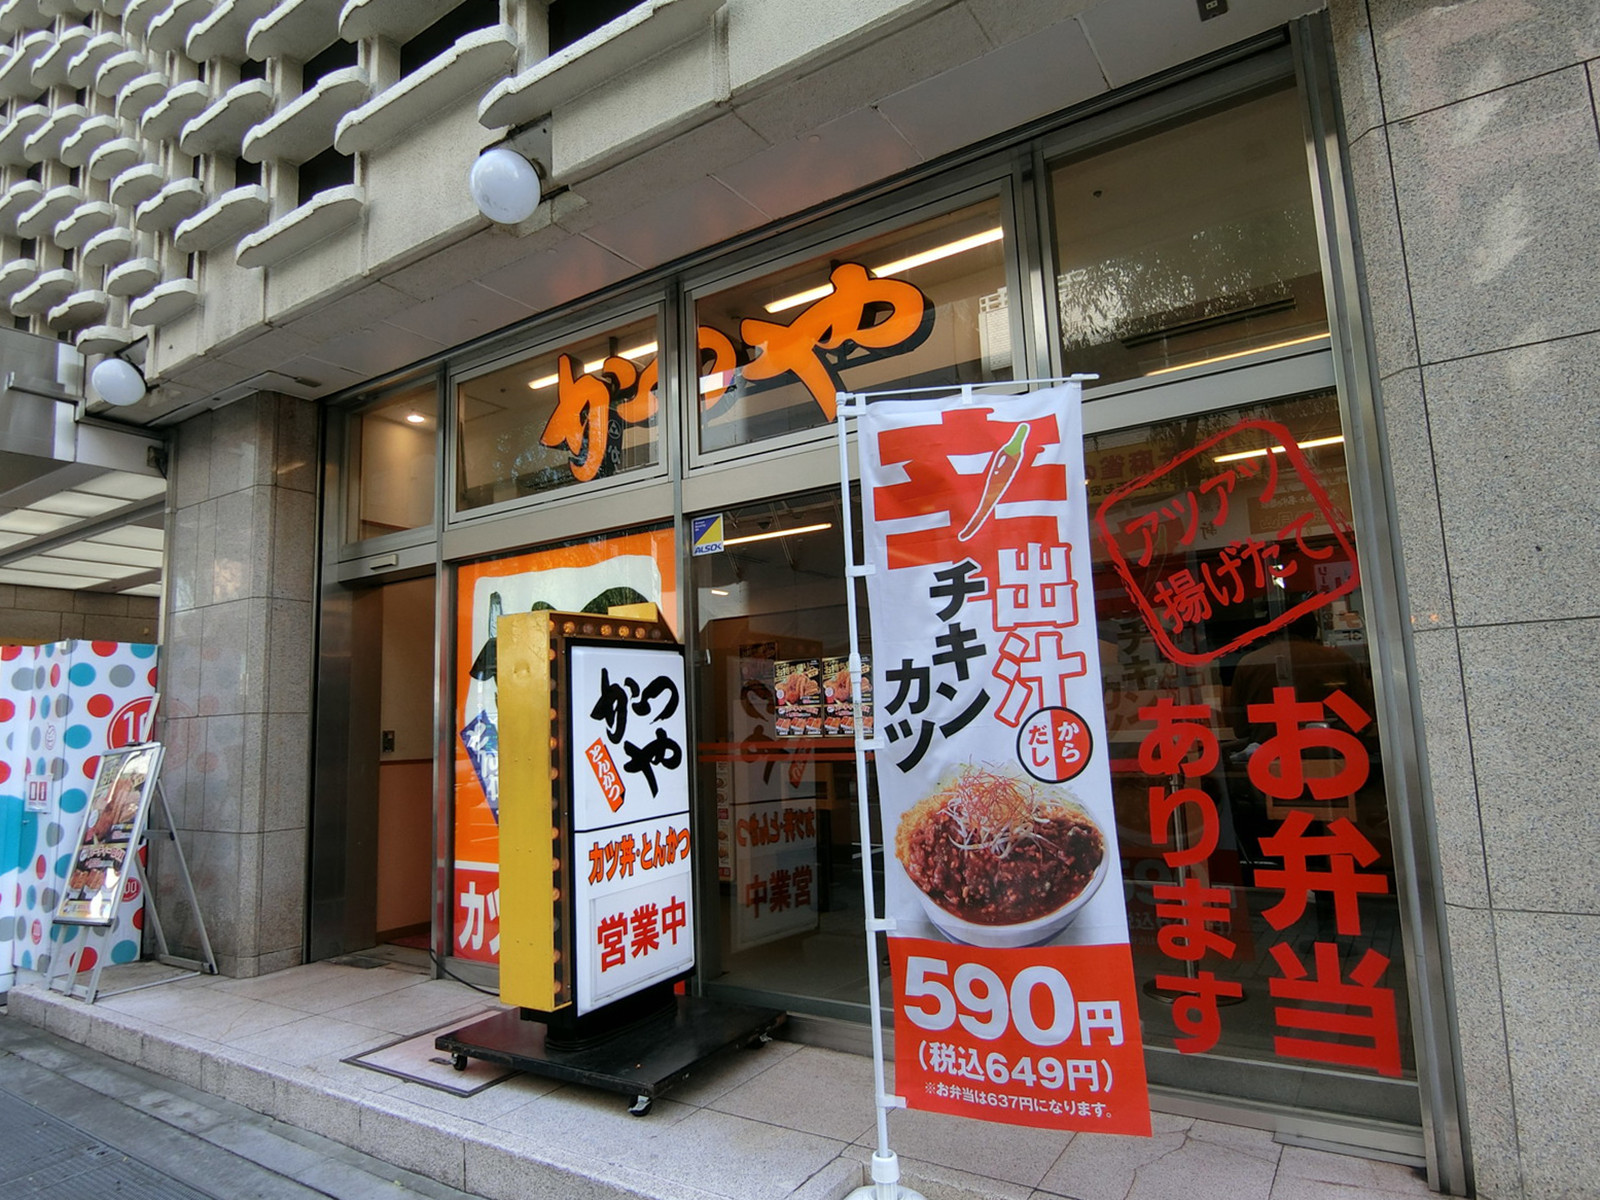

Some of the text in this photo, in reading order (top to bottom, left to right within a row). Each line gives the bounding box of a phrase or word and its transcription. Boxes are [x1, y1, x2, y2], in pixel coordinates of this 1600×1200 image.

[540, 262, 932, 482] かつや
[1125, 447, 1279, 567] アツアツ
[693, 543, 722, 555] ALSOK
[1154, 512, 1334, 634] 揚げたて
[1027, 724, 1050, 767] だし
[1057, 721, 1081, 763] から
[587, 826, 691, 886] カツ丼・とんかつ
[1138, 697, 1243, 1054] あります
[1247, 686, 1403, 1078] お弁当
[597, 896, 687, 973] 営業中
[904, 955, 1125, 1047] 590円
[918, 1039, 1113, 1093] (税込649円)
[924, 1081, 1113, 1119] ※お弁当は637円になります。
